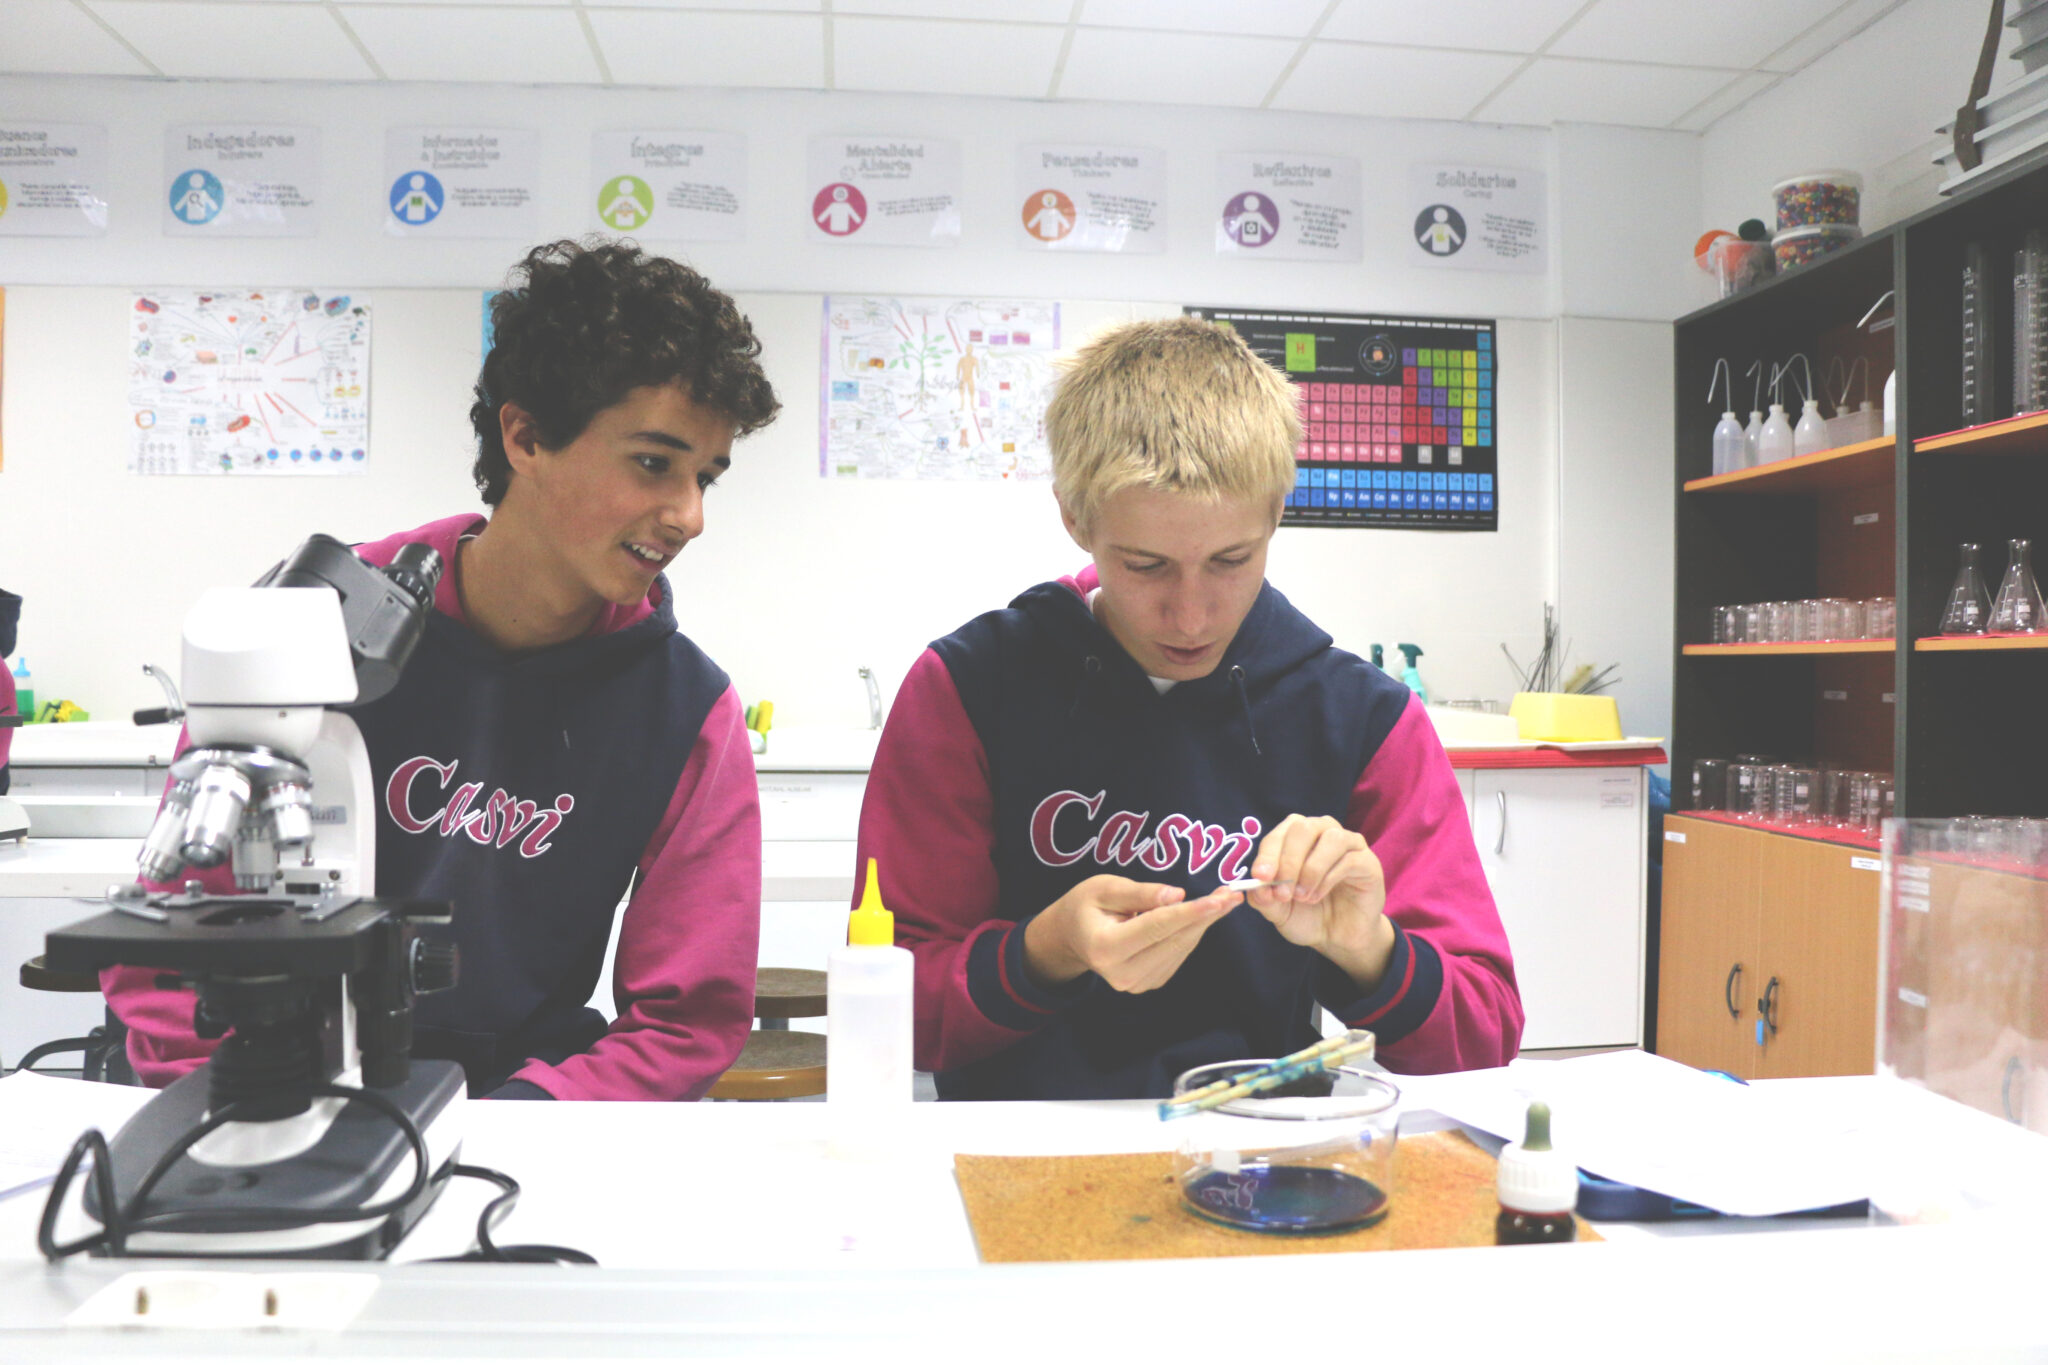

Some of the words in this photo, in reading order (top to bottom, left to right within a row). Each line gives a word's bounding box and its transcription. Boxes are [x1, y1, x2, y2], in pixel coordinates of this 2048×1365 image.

[1295, 342, 1305, 355] H
[386, 755, 574, 859] Casvi
[1030, 788, 1262, 885] Casvi
